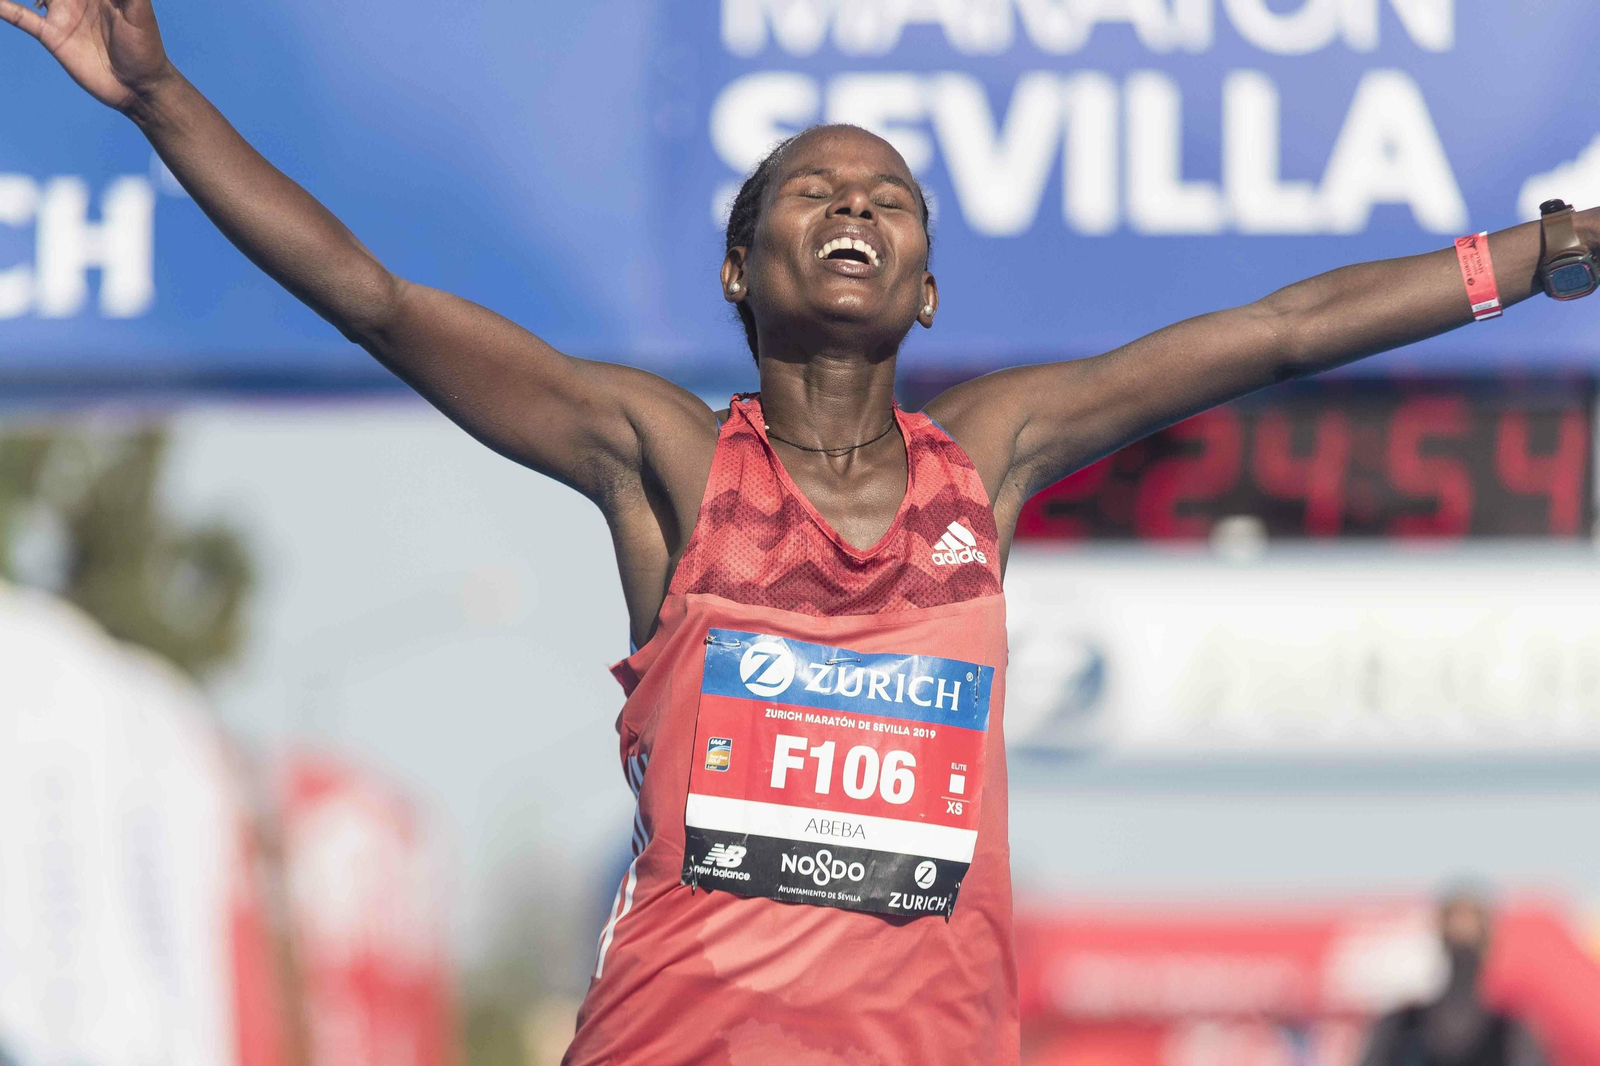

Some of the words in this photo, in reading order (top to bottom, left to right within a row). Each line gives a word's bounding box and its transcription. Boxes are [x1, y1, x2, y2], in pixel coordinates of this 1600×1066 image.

[711, 69, 1470, 236] SEVILLA
[804, 662, 962, 711] ZURICH
[765, 708, 803, 721] ZURICH
[804, 713, 856, 729] MARATÓN
[858, 720, 871, 730] DE
[873, 723, 910, 736] SEVILLA
[912, 727, 937, 739] 2019
[770, 733, 917, 805] F106
[951, 762, 968, 772] ELITE
[946, 801, 963, 815] XS
[804, 817, 866, 840] ABEBA
[694, 864, 712, 875] new
[712, 866, 751, 881] balance
[778, 884, 826, 898] AYUNTAMIENTO
[827, 891, 836, 899] DE
[837, 891, 861, 903] SEVILLA
[888, 891, 948, 912] ZURICH
